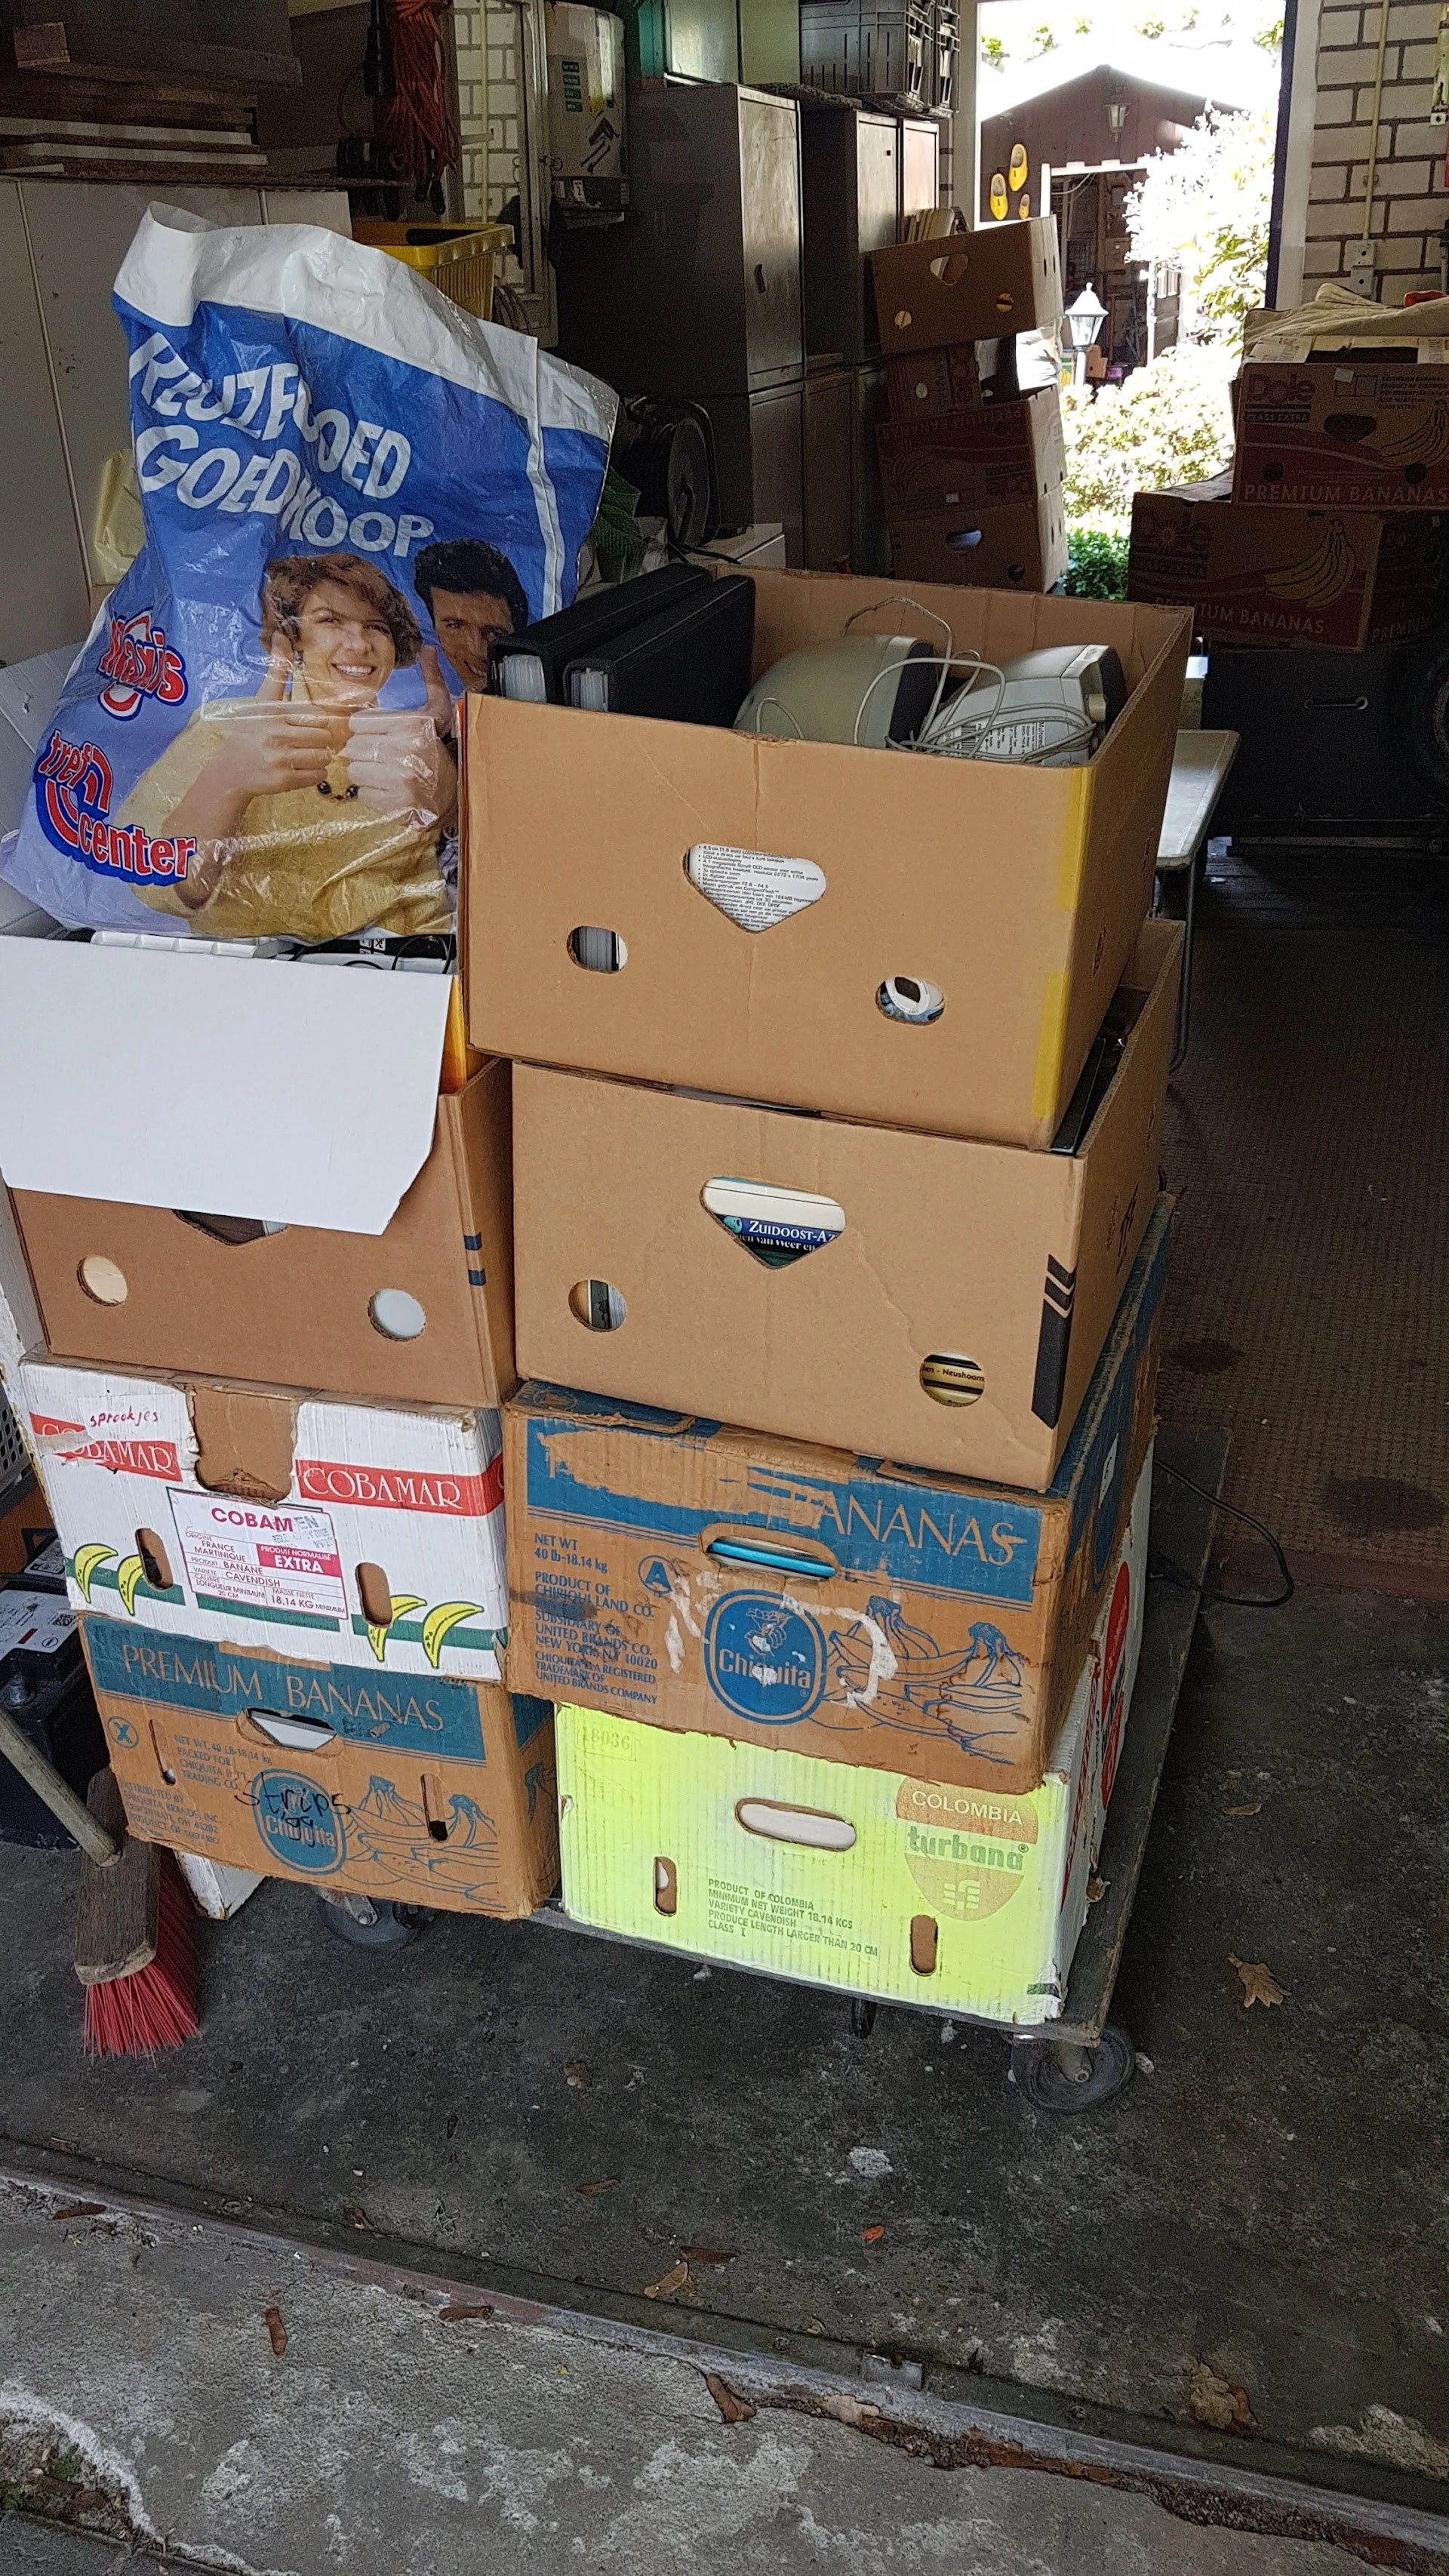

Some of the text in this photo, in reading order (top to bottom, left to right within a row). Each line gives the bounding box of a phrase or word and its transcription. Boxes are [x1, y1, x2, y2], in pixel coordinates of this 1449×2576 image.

[1248, 374, 1315, 403] Dole
[1246, 411, 1310, 423] CLASS EXTRA
[1244, 483, 1449, 503] PREMIUM BANANAS
[1239, 604, 1327, 636] BANANAS
[98, 615, 186, 703] Maxis
[78, 811, 196, 879] center
[90, 1405, 158, 1427] sprookjes
[303, 1467, 463, 1510] COBAMAR
[800, 1485, 1015, 1566] ANANAS
[202, 1540, 235, 1553] FRANCE
[260, 1545, 290, 1555] PRODUIT
[534, 1533, 578, 1550] NET WT
[194, 1546, 247, 1562] MARTINIQUE
[274, 1555, 324, 1574] EXTRA
[534, 1547, 548, 1559] 40
[595, 1558, 608, 1574] kg
[223, 1561, 263, 1575] BANANE
[226, 1571, 280, 1587] CAVENDISH
[196, 1580, 232, 1591] LONGUEUR
[535, 1571, 611, 1595] PRODUCT OF
[299, 1599, 314, 1608] KG
[595, 1596, 629, 1612] LAND
[632, 1604, 654, 1618] CO.
[535, 1610, 601, 1634] SUBSIDIARY
[535, 1623, 652, 1656] UNITED BRANDS CO.
[536, 1635, 562, 1649] NEW
[625, 1653, 657, 1670] 10020
[535, 1651, 581, 1667] CHIQUITA
[603, 1664, 656, 1684] REGISTERED
[535, 1661, 589, 1680] TRADEMARK
[592, 1673, 605, 1683] OF
[122, 1644, 445, 1731] PREMIUM BANANAS
[536, 1671, 657, 1704] UNITED BRANDS COMPANY
[174, 1734, 189, 1745] NET
[177, 1747, 231, 1766] PACKED FOR
[180, 1759, 222, 1774] CHIQUITA
[182, 1770, 221, 1787] TRADING
[234, 1771, 352, 1817] strips
[912, 1790, 1023, 1825] COLOMBIA
[908, 1825, 1023, 1871] turbana
[709, 1878, 814, 1910] PRODUCT OF COLOMBIA
[709, 1888, 853, 1929] MINIMUM NET WEIGHT 18.14 KGS
[709, 1899, 796, 1928] VARIETY CAVENDISH
[708, 1919, 734, 1934] CLASS
[709, 1910, 878, 1956] PRODUCE LENGTH LARGER THAN 20 CM
